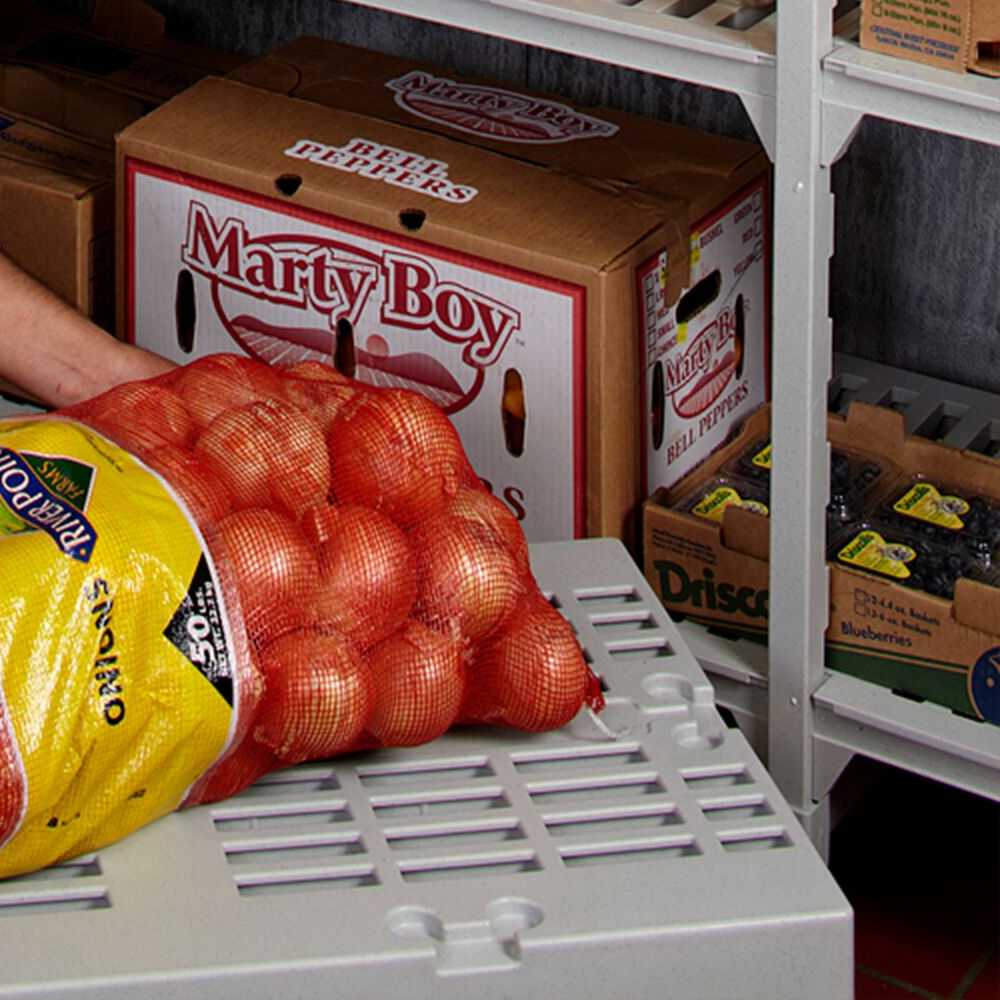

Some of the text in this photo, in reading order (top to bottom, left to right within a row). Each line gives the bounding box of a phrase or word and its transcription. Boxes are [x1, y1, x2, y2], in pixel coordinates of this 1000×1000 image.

[396, 74, 614, 135] Marty Boy
[291, 142, 476, 201] PEPPERS
[347, 139, 450, 178] BELL
[182, 200, 520, 366] Marty Boy
[664, 335, 714, 392] Marty
[666, 381, 749, 467] BELL PEPPERS
[37, 460, 86, 501] FARMS
[27, 498, 92, 552] RIVER
[83, 576, 126, 727] ONIONS
[186, 613, 217, 668] 50
[840, 621, 914, 648] Blueberries
